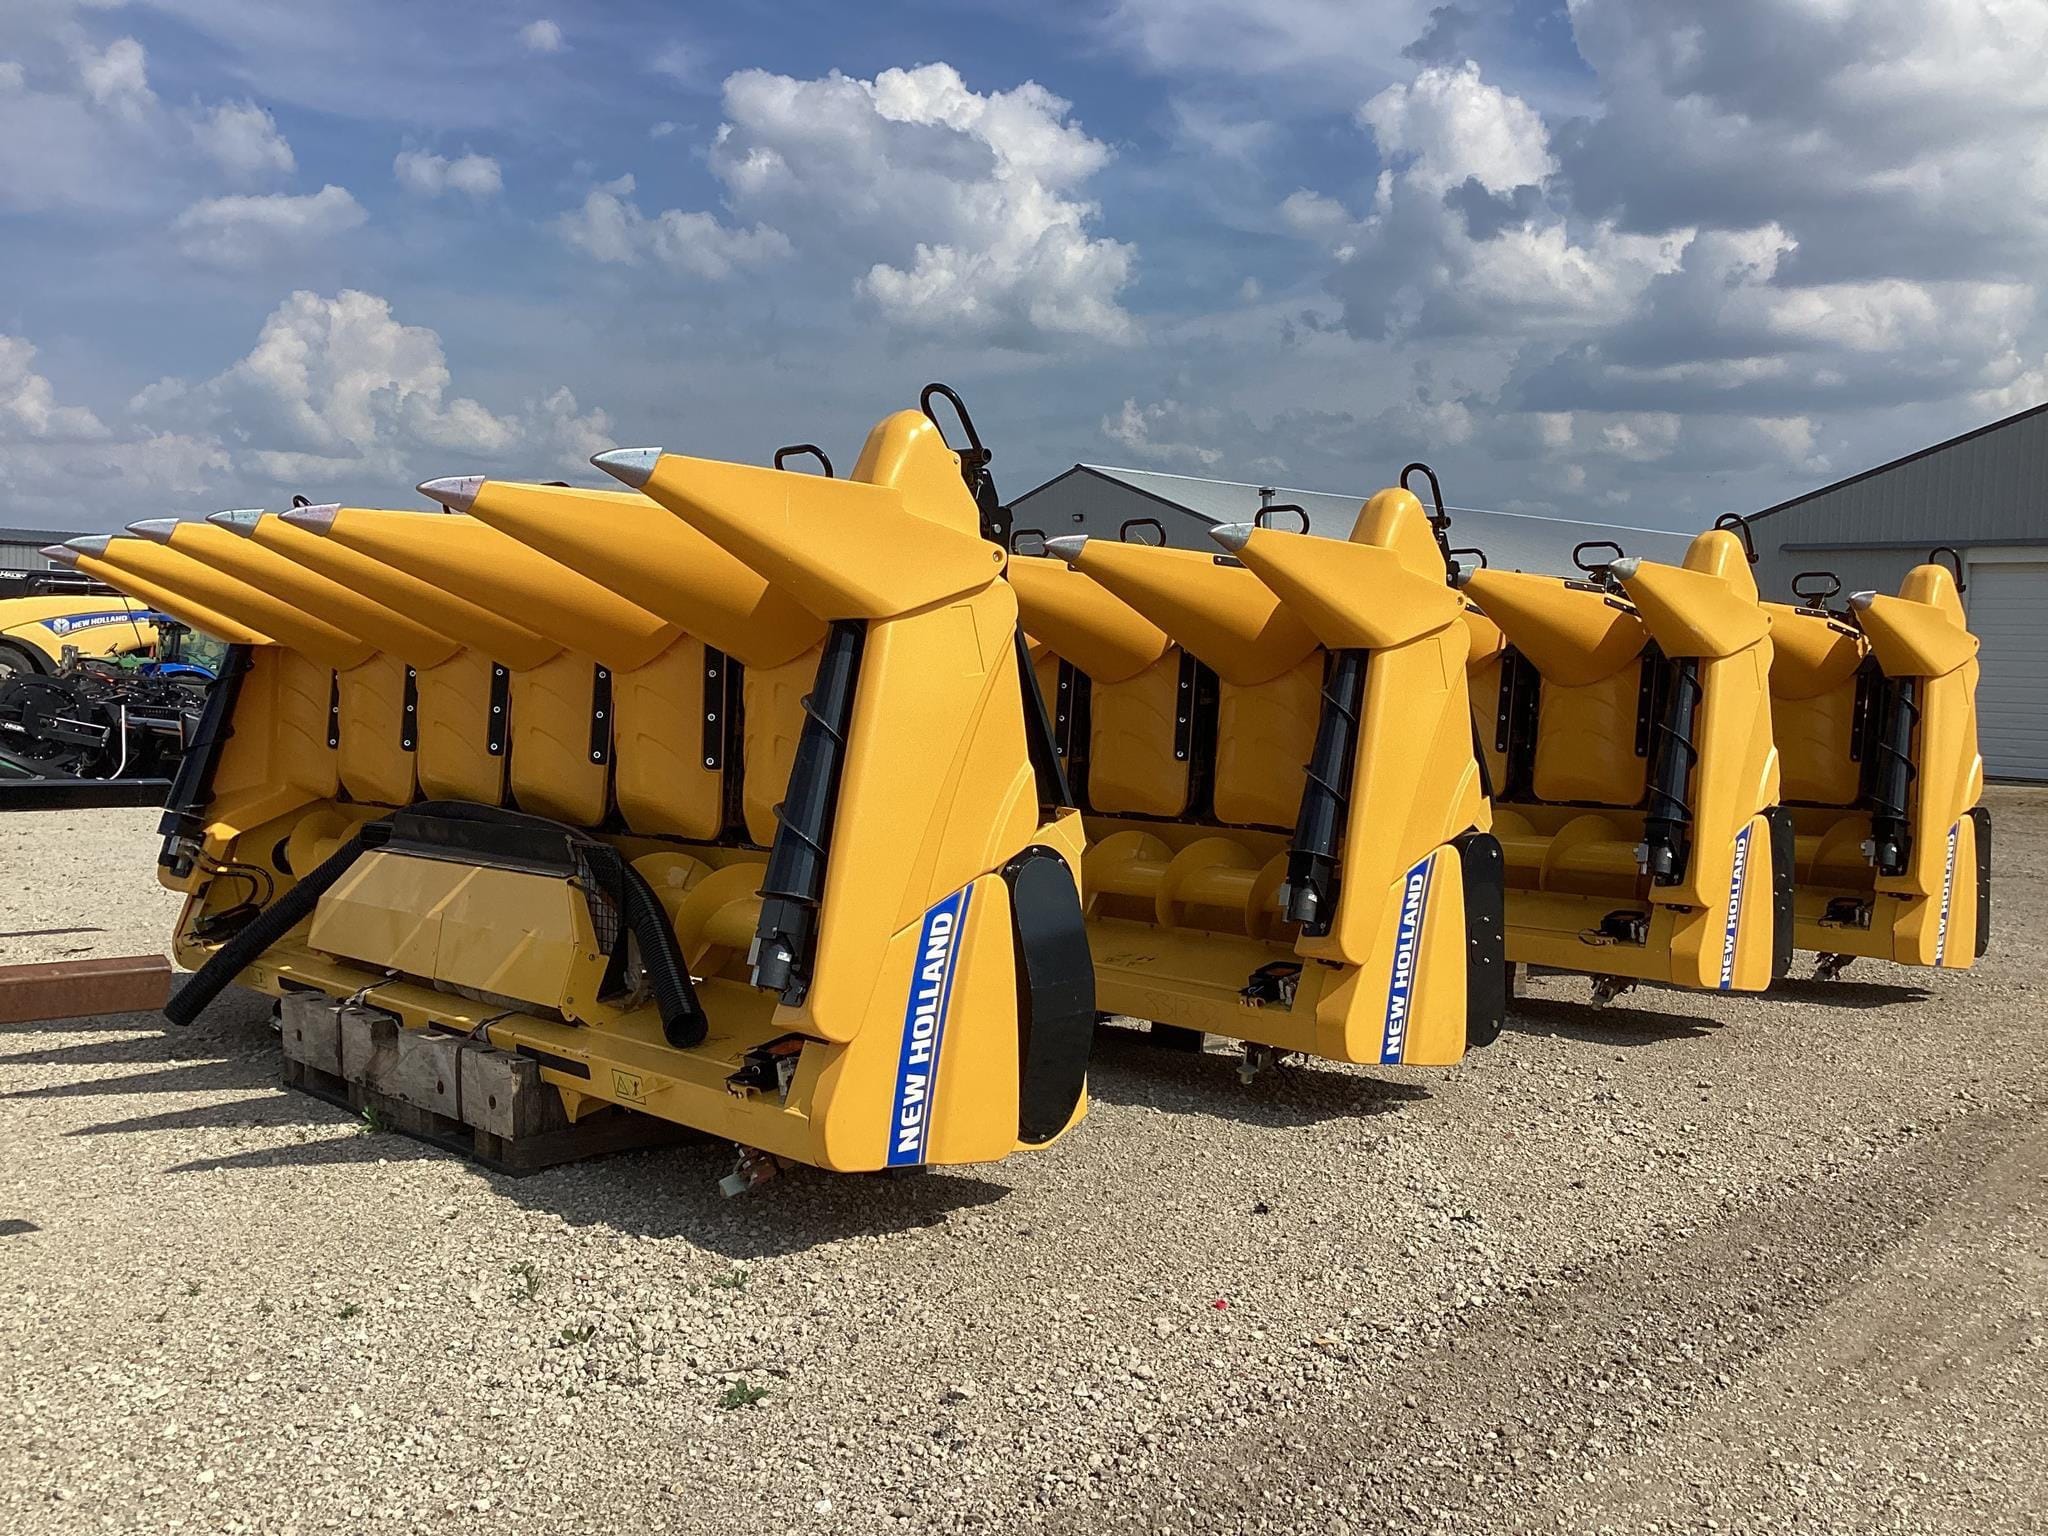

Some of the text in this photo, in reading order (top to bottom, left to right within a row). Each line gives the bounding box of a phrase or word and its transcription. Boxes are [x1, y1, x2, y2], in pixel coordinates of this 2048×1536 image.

[72, 620, 90, 629] NEW
[91, 615, 128, 624] HOLLAND
[1386, 873, 1424, 1056] NEW HOLLAND
[1721, 837, 1747, 983] NEW HOLLAND
[1936, 833, 1955, 960] NEW HOLLAND
[897, 911, 954, 1153] NEW HOLLAND
